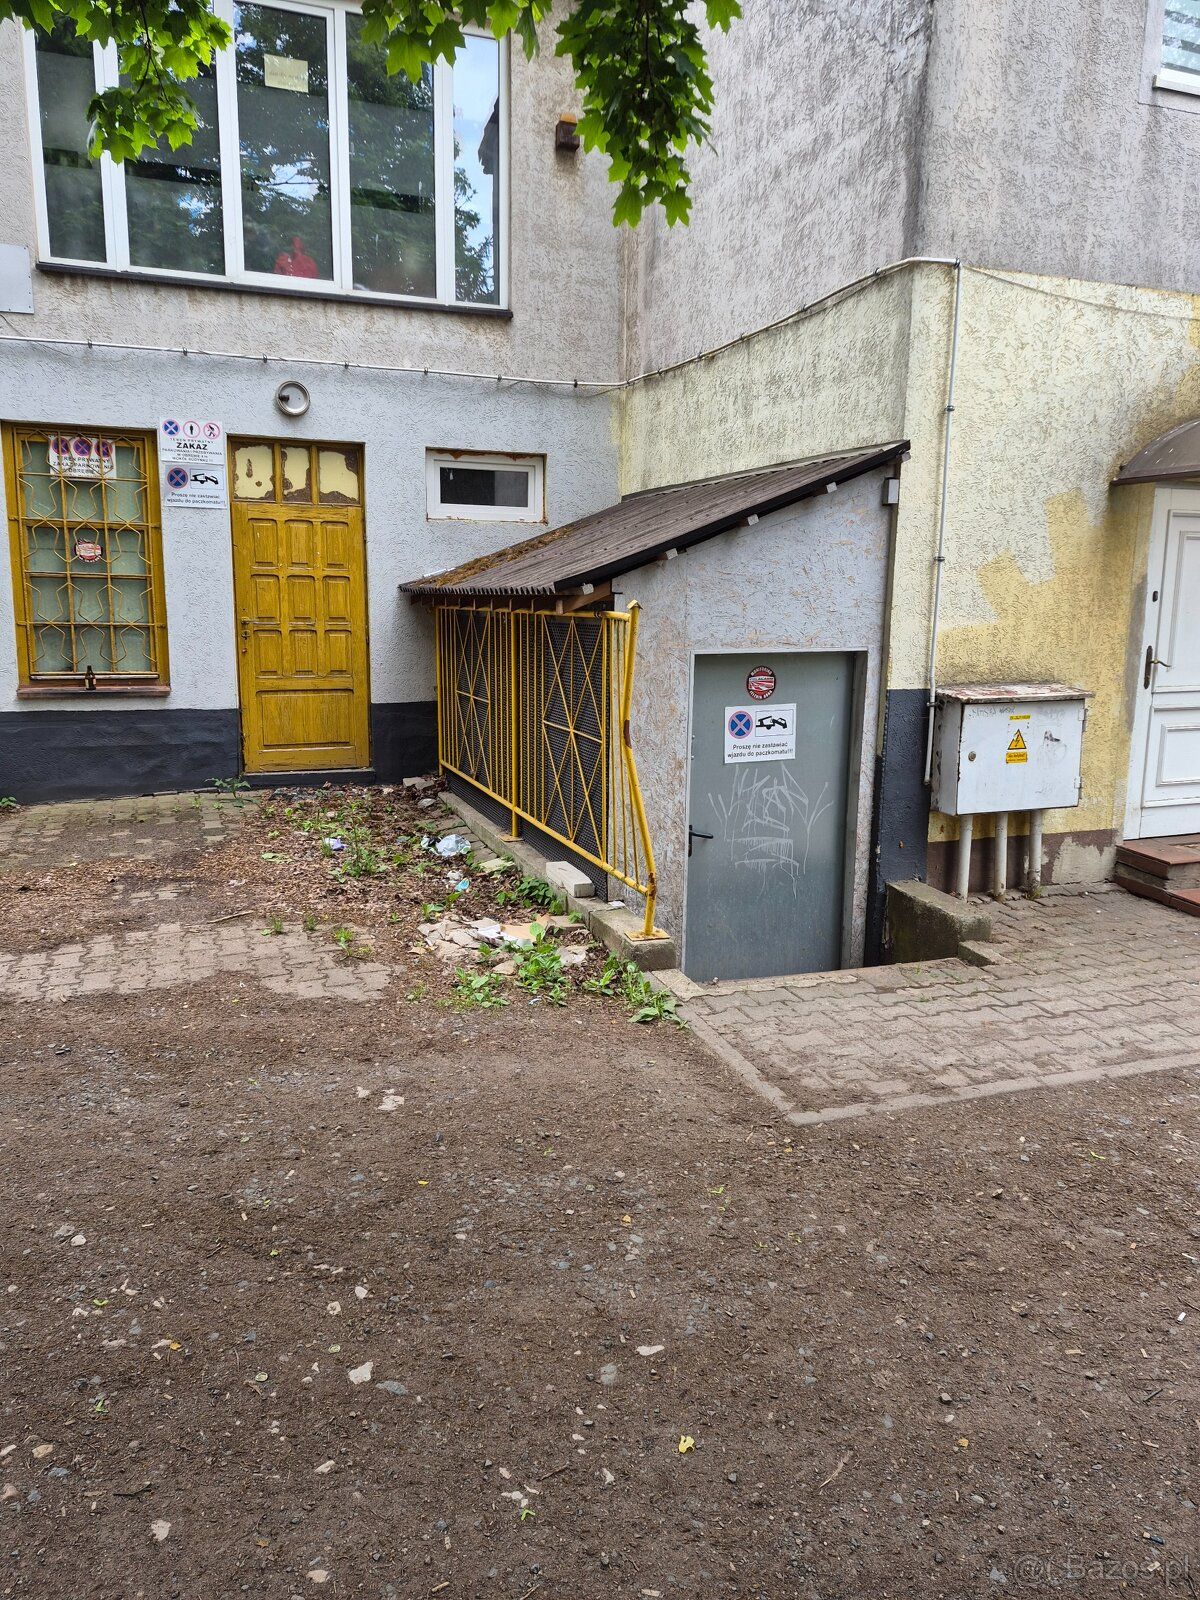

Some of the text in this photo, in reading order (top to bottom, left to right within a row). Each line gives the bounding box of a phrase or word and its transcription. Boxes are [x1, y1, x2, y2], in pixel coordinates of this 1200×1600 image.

[176, 442, 208, 450] ZAKAZ
[762, 741, 788, 749] zastawiać
[727, 751, 746, 759] wjazdu
[755, 748, 794, 757] paczkomatu!!!
